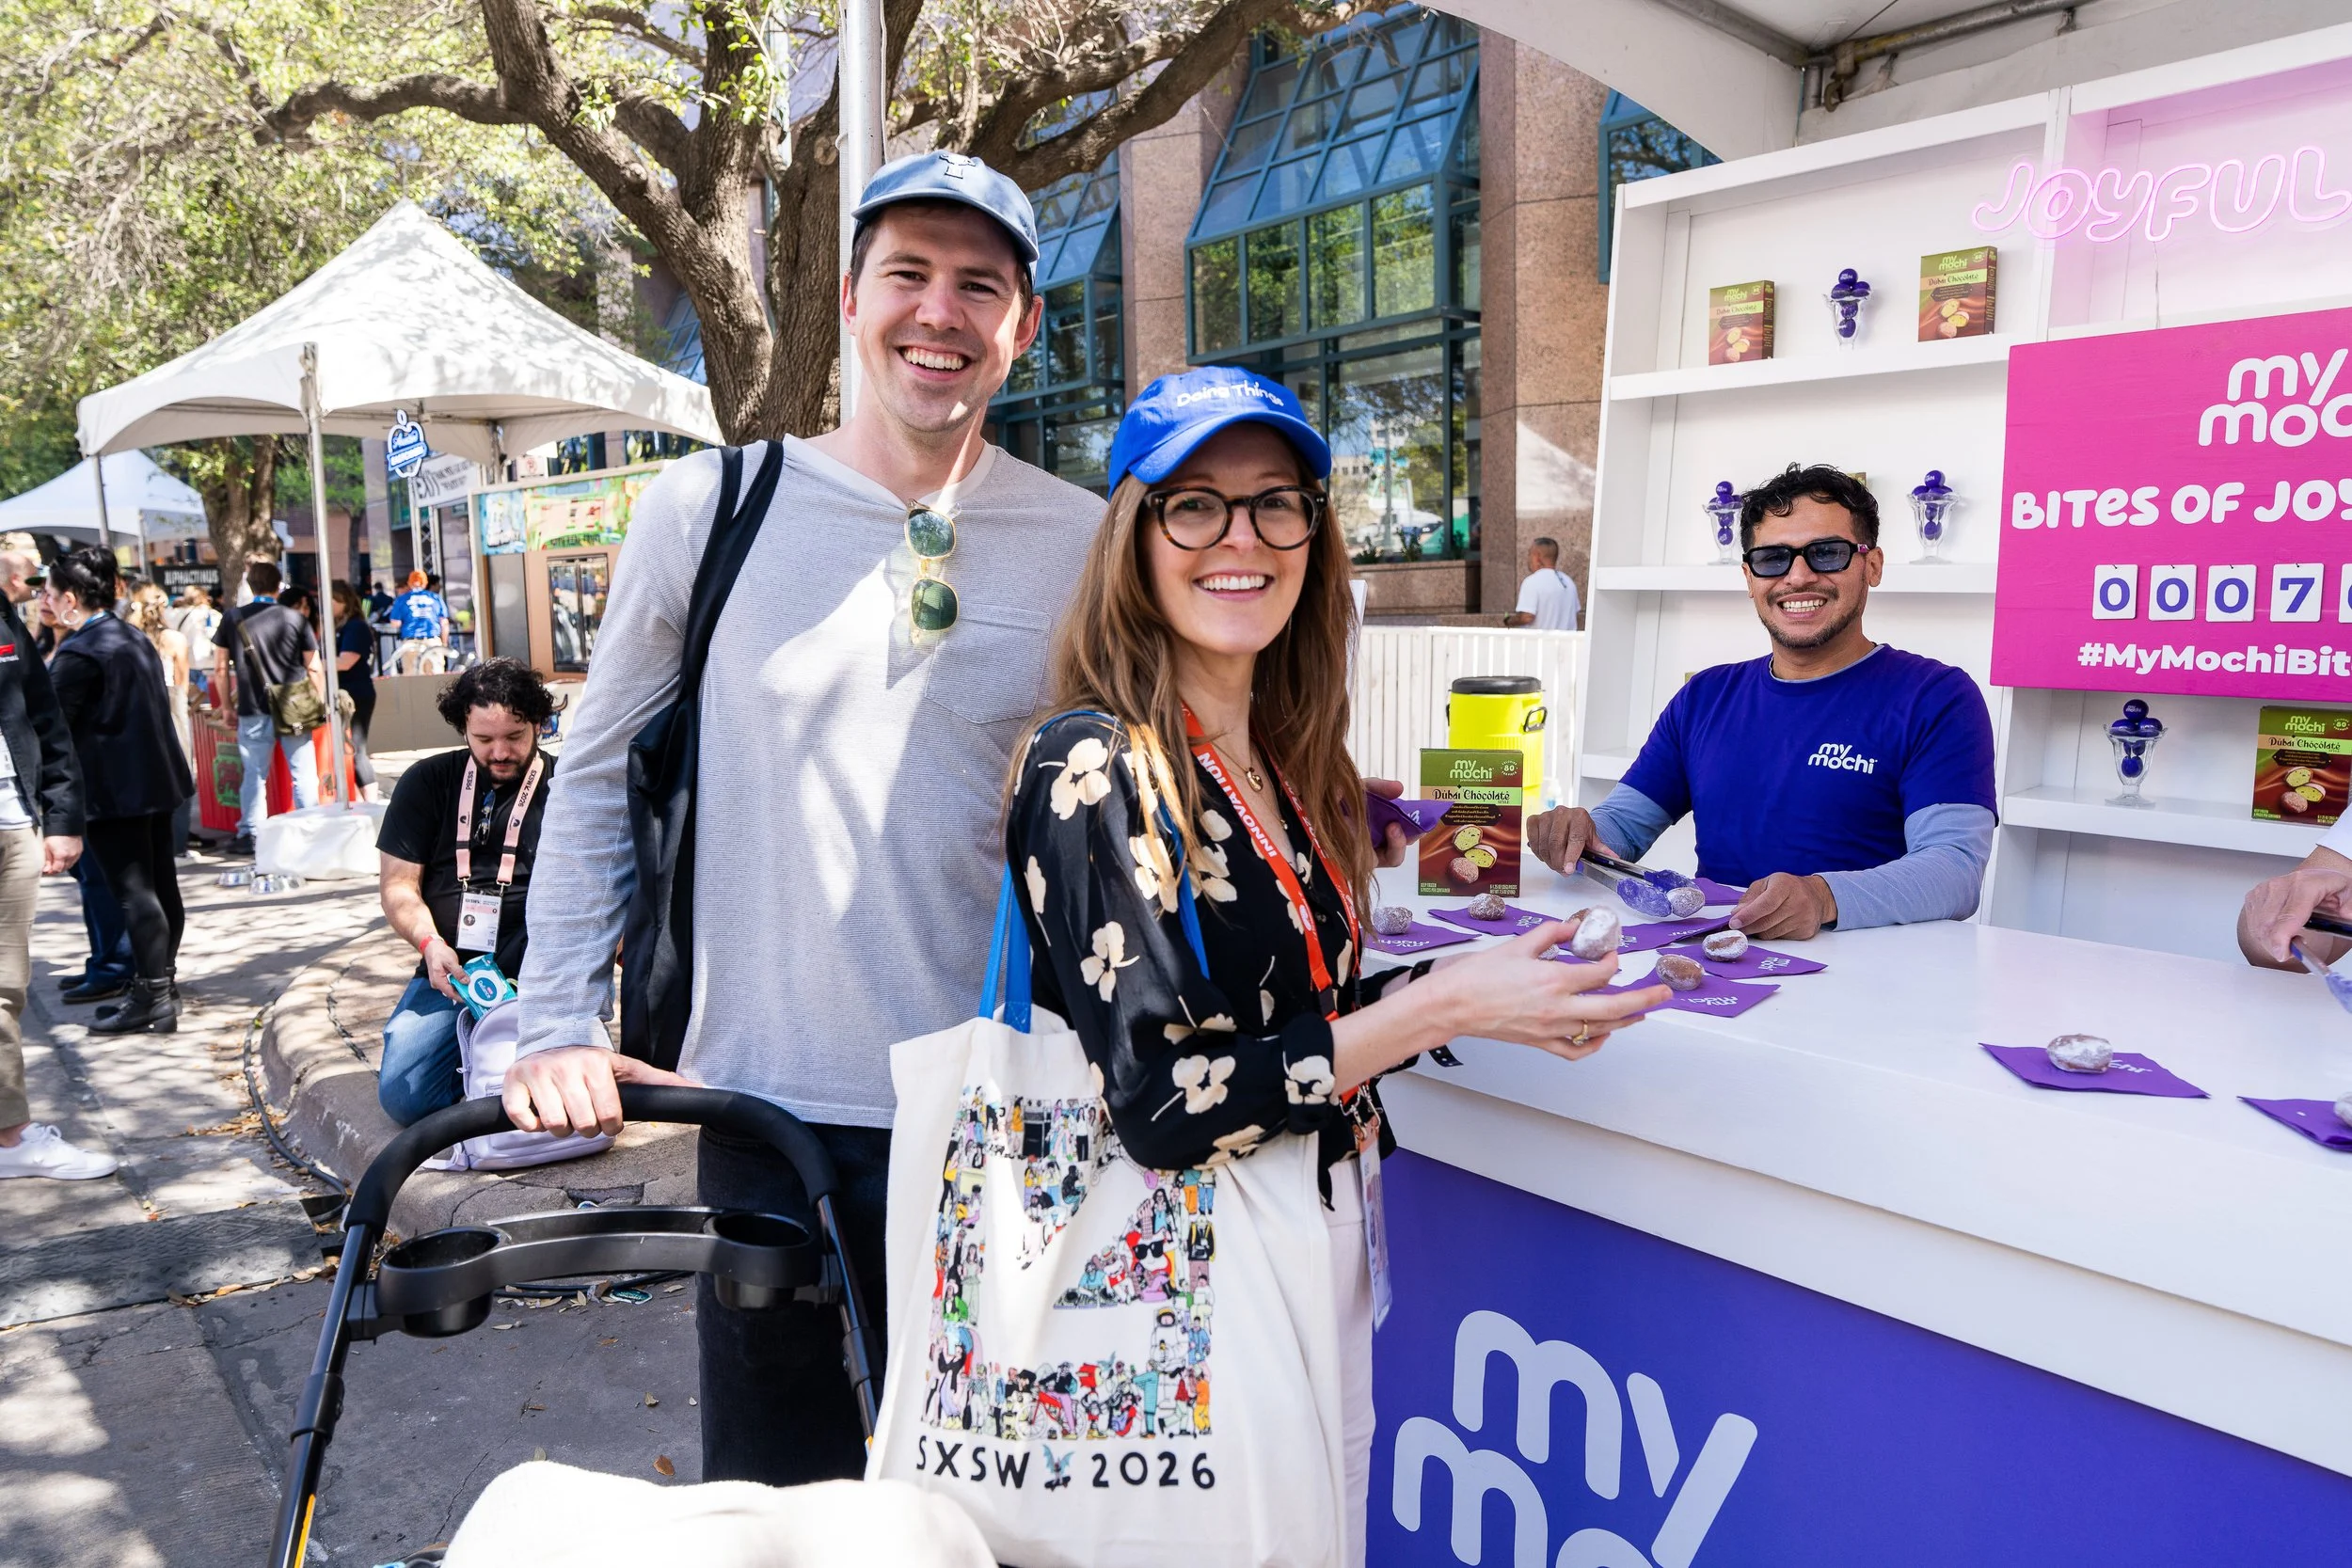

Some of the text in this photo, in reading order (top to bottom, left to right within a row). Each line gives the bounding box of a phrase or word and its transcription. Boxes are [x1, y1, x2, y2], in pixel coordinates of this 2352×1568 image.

[2227, 348, 2349, 406] my
[1177, 380, 1285, 407] Doing Things
[2170, 482, 2246, 524] OF
[2077, 642, 2352, 676] #MyMochiBit
[2285, 721, 2326, 733] mochi
[2290, 715, 2312, 724] my
[1818, 742, 1853, 760] my
[1449, 767, 1494, 779] mochi
[1454, 759, 1477, 771] my
[1807, 753, 1875, 774] mochi
[465, 770, 474, 791] PRESS
[1196, 752, 1278, 858] INNOVATION
[1453, 1310, 1757, 1568] my
[916, 1435, 1216, 1490] SXSW 2026
